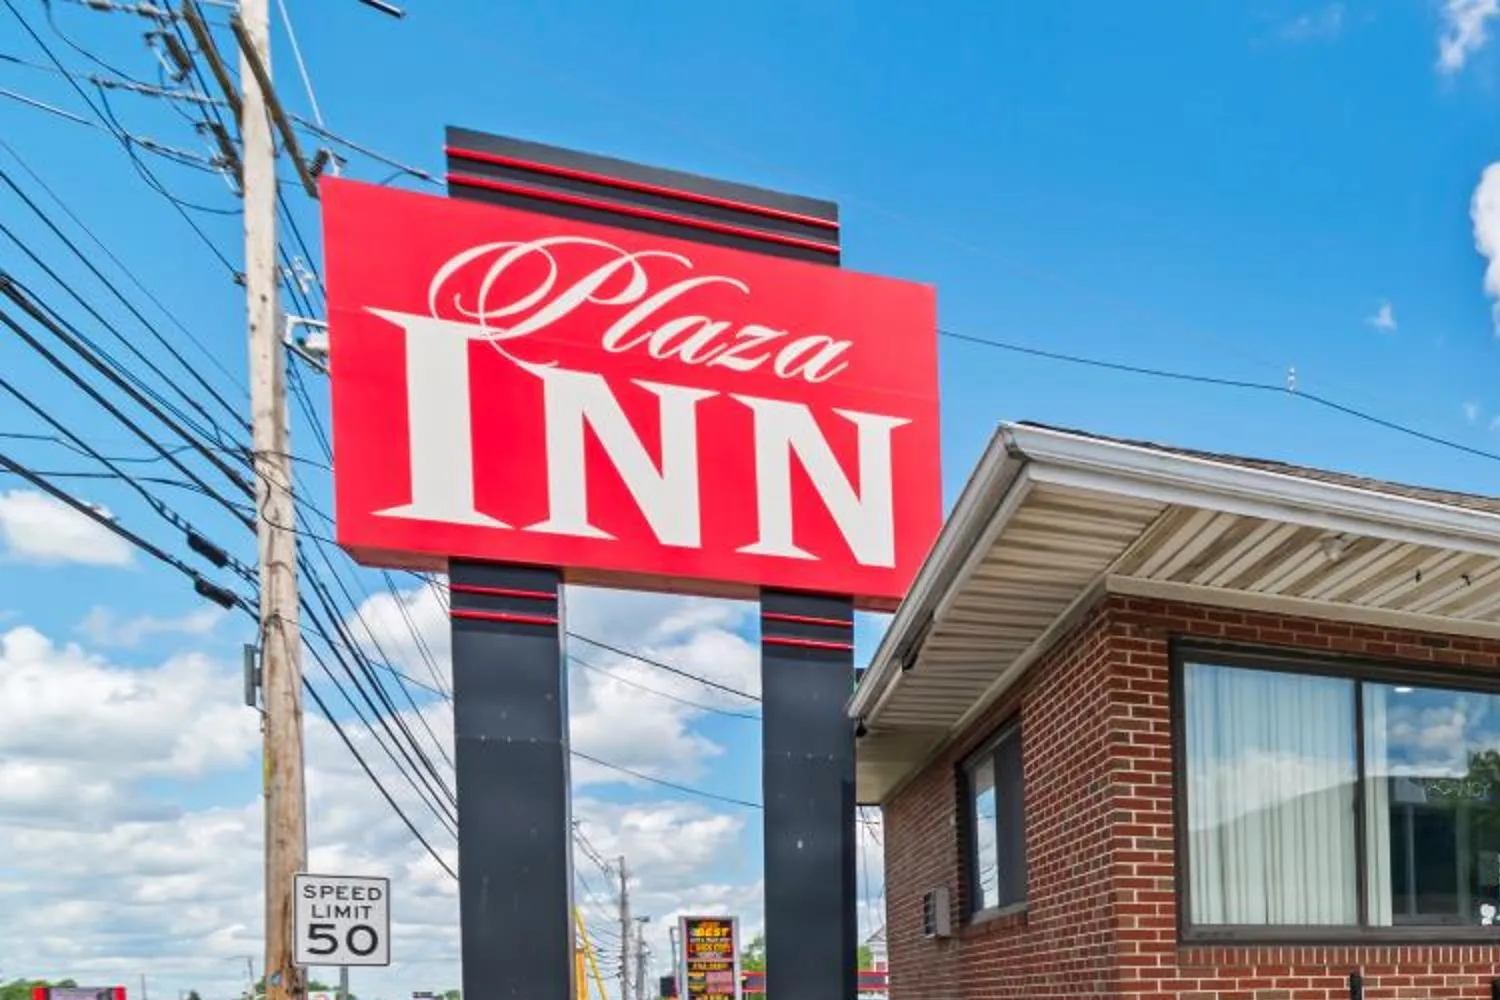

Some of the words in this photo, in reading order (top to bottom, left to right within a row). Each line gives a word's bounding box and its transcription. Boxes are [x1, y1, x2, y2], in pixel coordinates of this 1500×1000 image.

[428, 236, 854, 383] Plaza
[362, 305, 913, 569] INN
[303, 885, 382, 901] SPEED
[311, 904, 372, 919] LIMIT
[306, 924, 378, 957] 50
